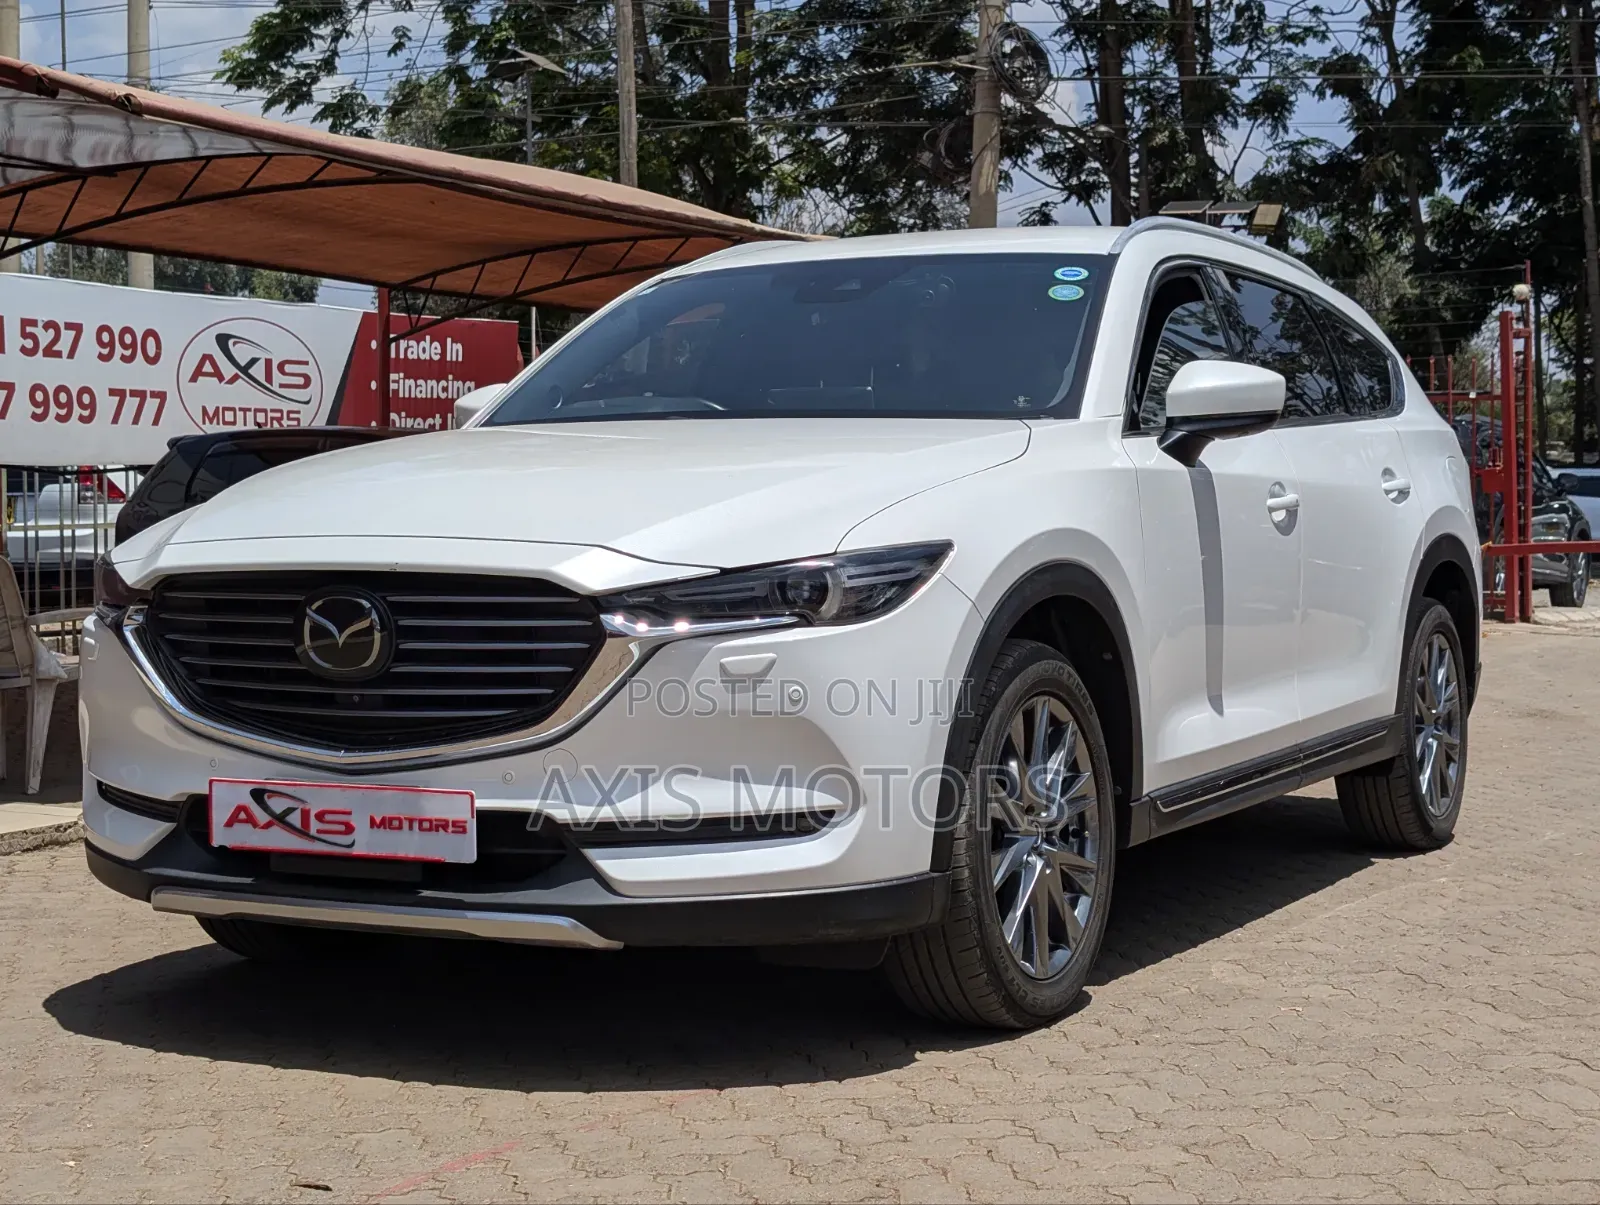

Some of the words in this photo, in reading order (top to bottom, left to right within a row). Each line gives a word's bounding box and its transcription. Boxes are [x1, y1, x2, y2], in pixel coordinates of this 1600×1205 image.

[19, 317, 84, 360] 527
[95, 324, 162, 366] 990
[389, 333, 442, 361] Trade
[446, 337, 463, 362] In
[188, 343, 313, 397] AXIS
[0, 381, 16, 421] 7
[28, 383, 98, 425] 999
[108, 387, 168, 427] 777
[202, 405, 302, 428] MOTORS
[223, 796, 356, 843] AXIS
[369, 814, 468, 835] MOTORS
